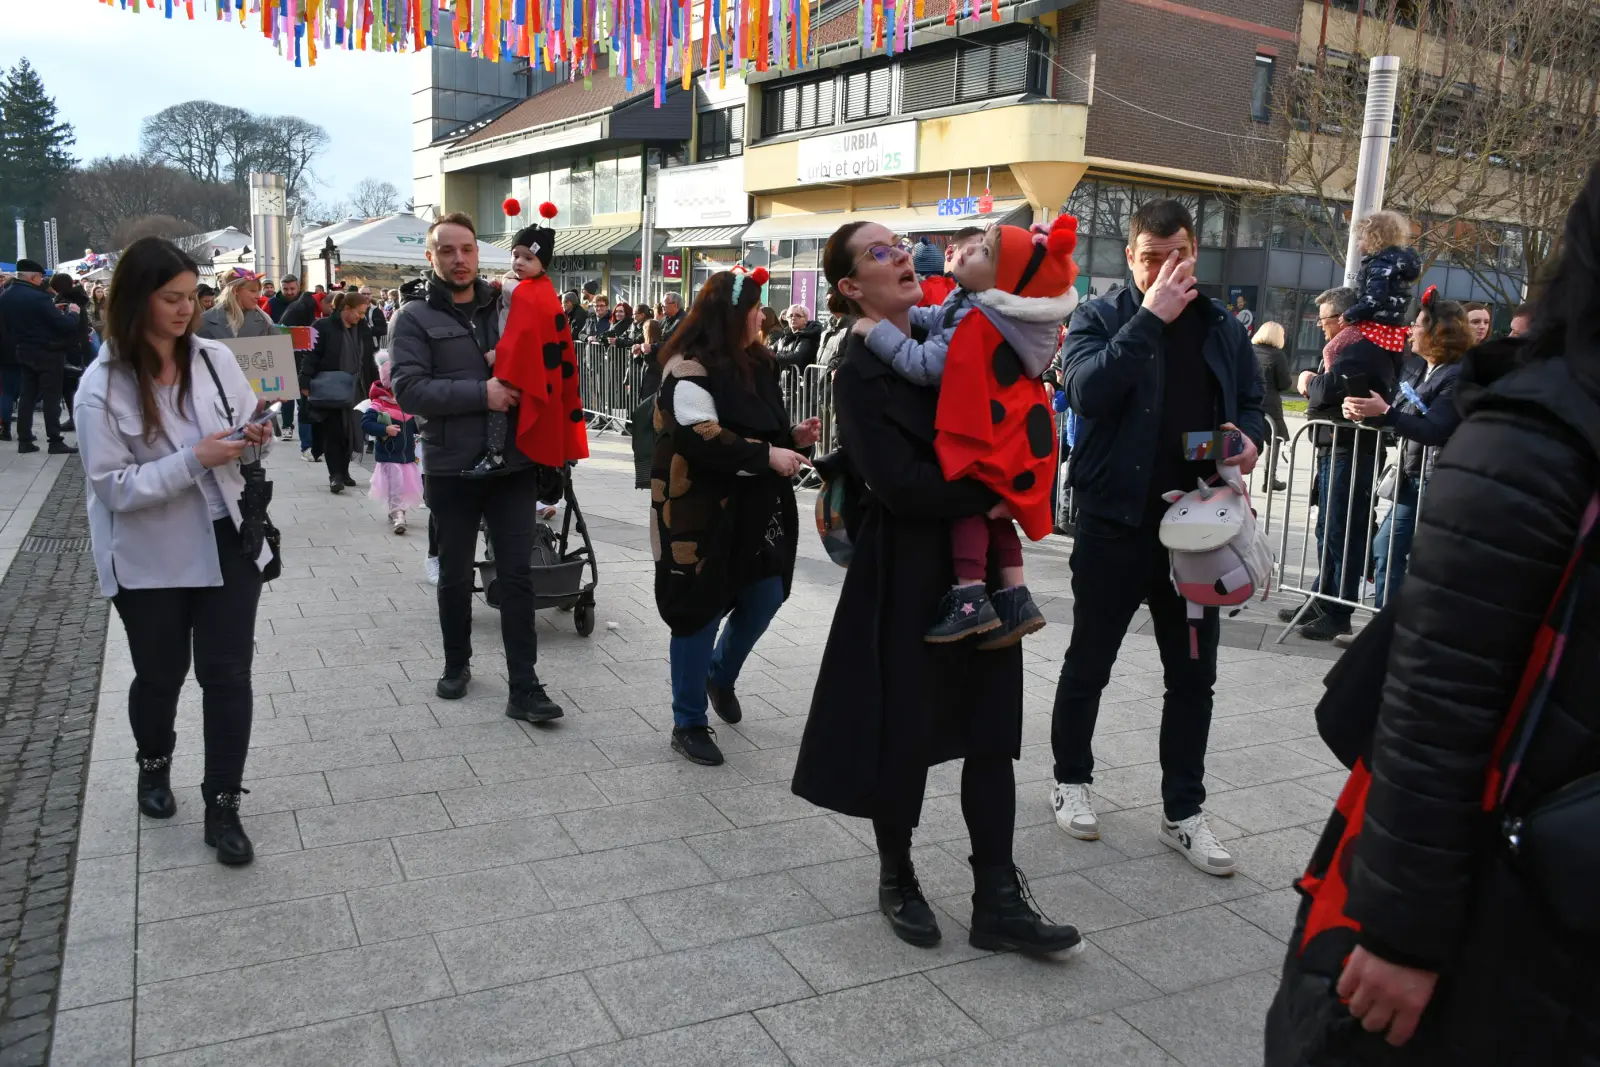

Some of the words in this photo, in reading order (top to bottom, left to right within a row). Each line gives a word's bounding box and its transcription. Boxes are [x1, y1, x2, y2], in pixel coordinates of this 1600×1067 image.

[844, 132, 878, 152] URBIA
[807, 161, 831, 179] urbi
[835, 159, 848, 176] et
[884, 152, 902, 171] 25
[938, 197, 977, 216] ERSTE
